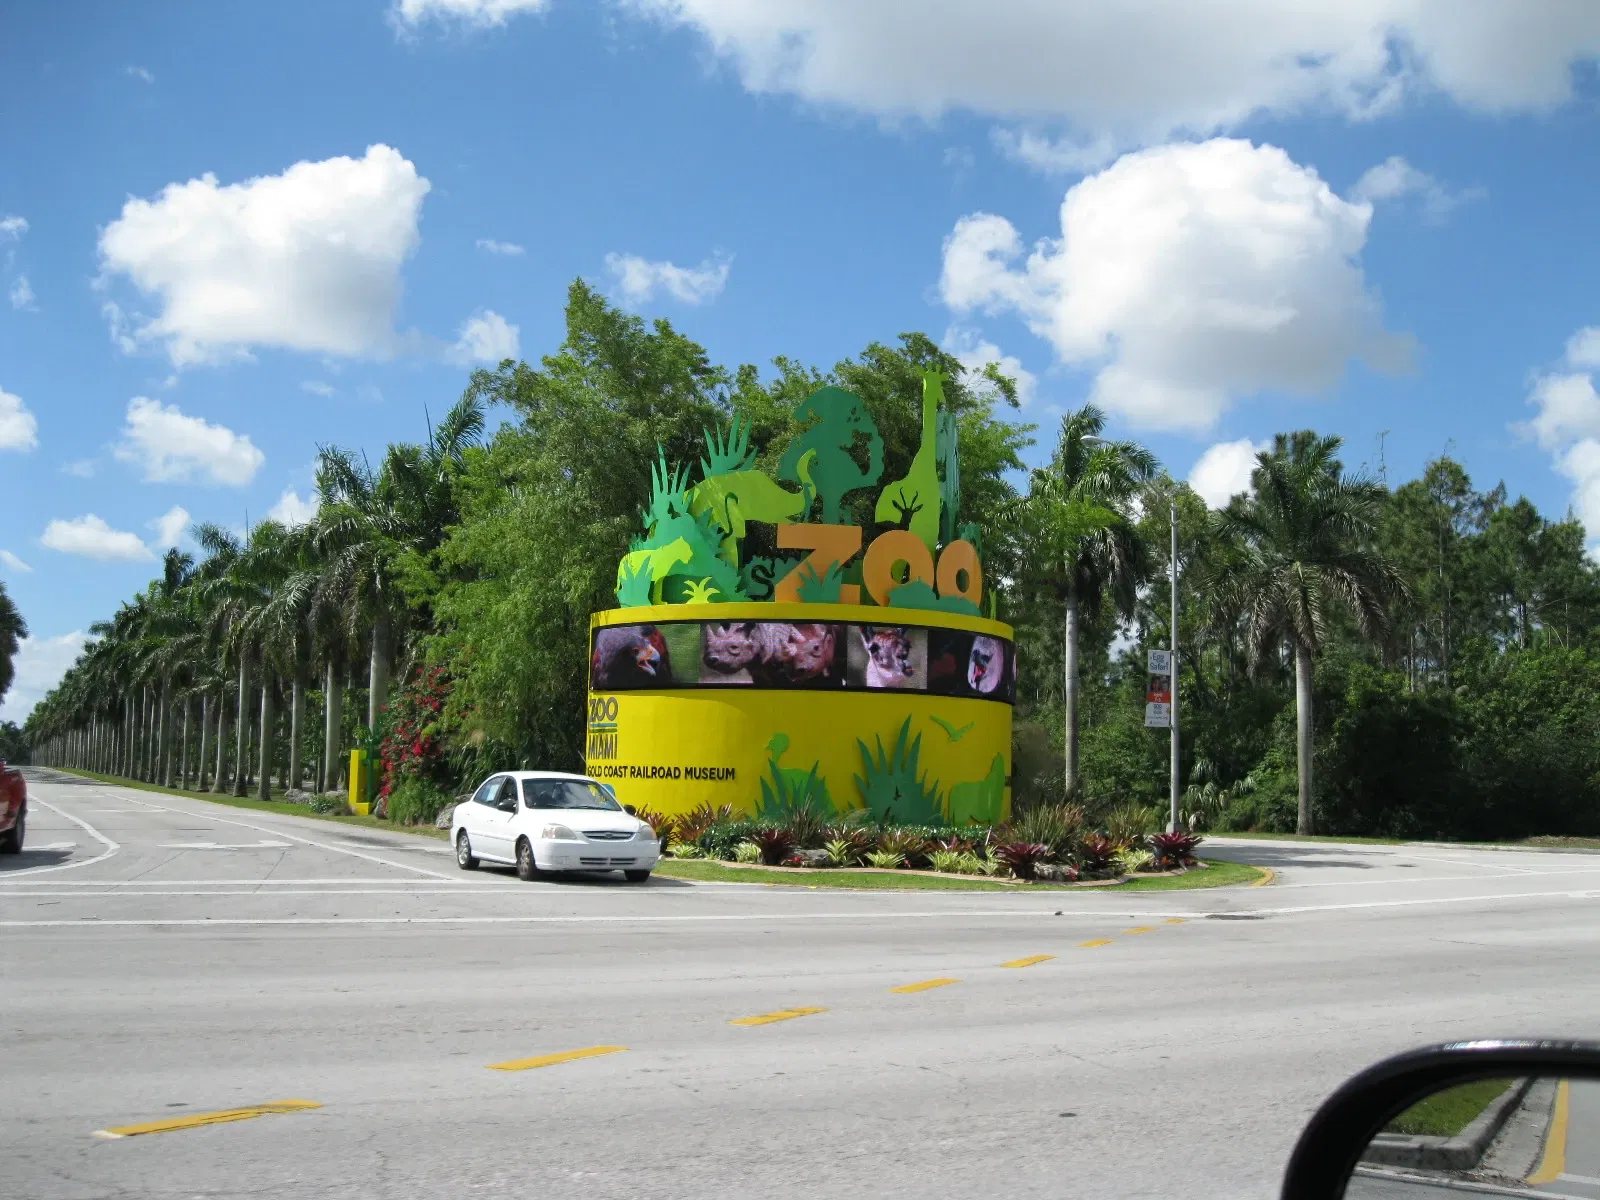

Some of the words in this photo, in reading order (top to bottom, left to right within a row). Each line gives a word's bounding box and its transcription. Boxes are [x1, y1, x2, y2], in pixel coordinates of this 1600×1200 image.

[1149, 661, 1169, 671] Safari
[589, 697, 618, 722] ZOO
[588, 734, 617, 760] MIAMI
[588, 766, 602, 778] GOLD
[603, 766, 628, 779] COAST
[630, 766, 681, 779] RAILROAD
[684, 767, 735, 780] MUSEUM
